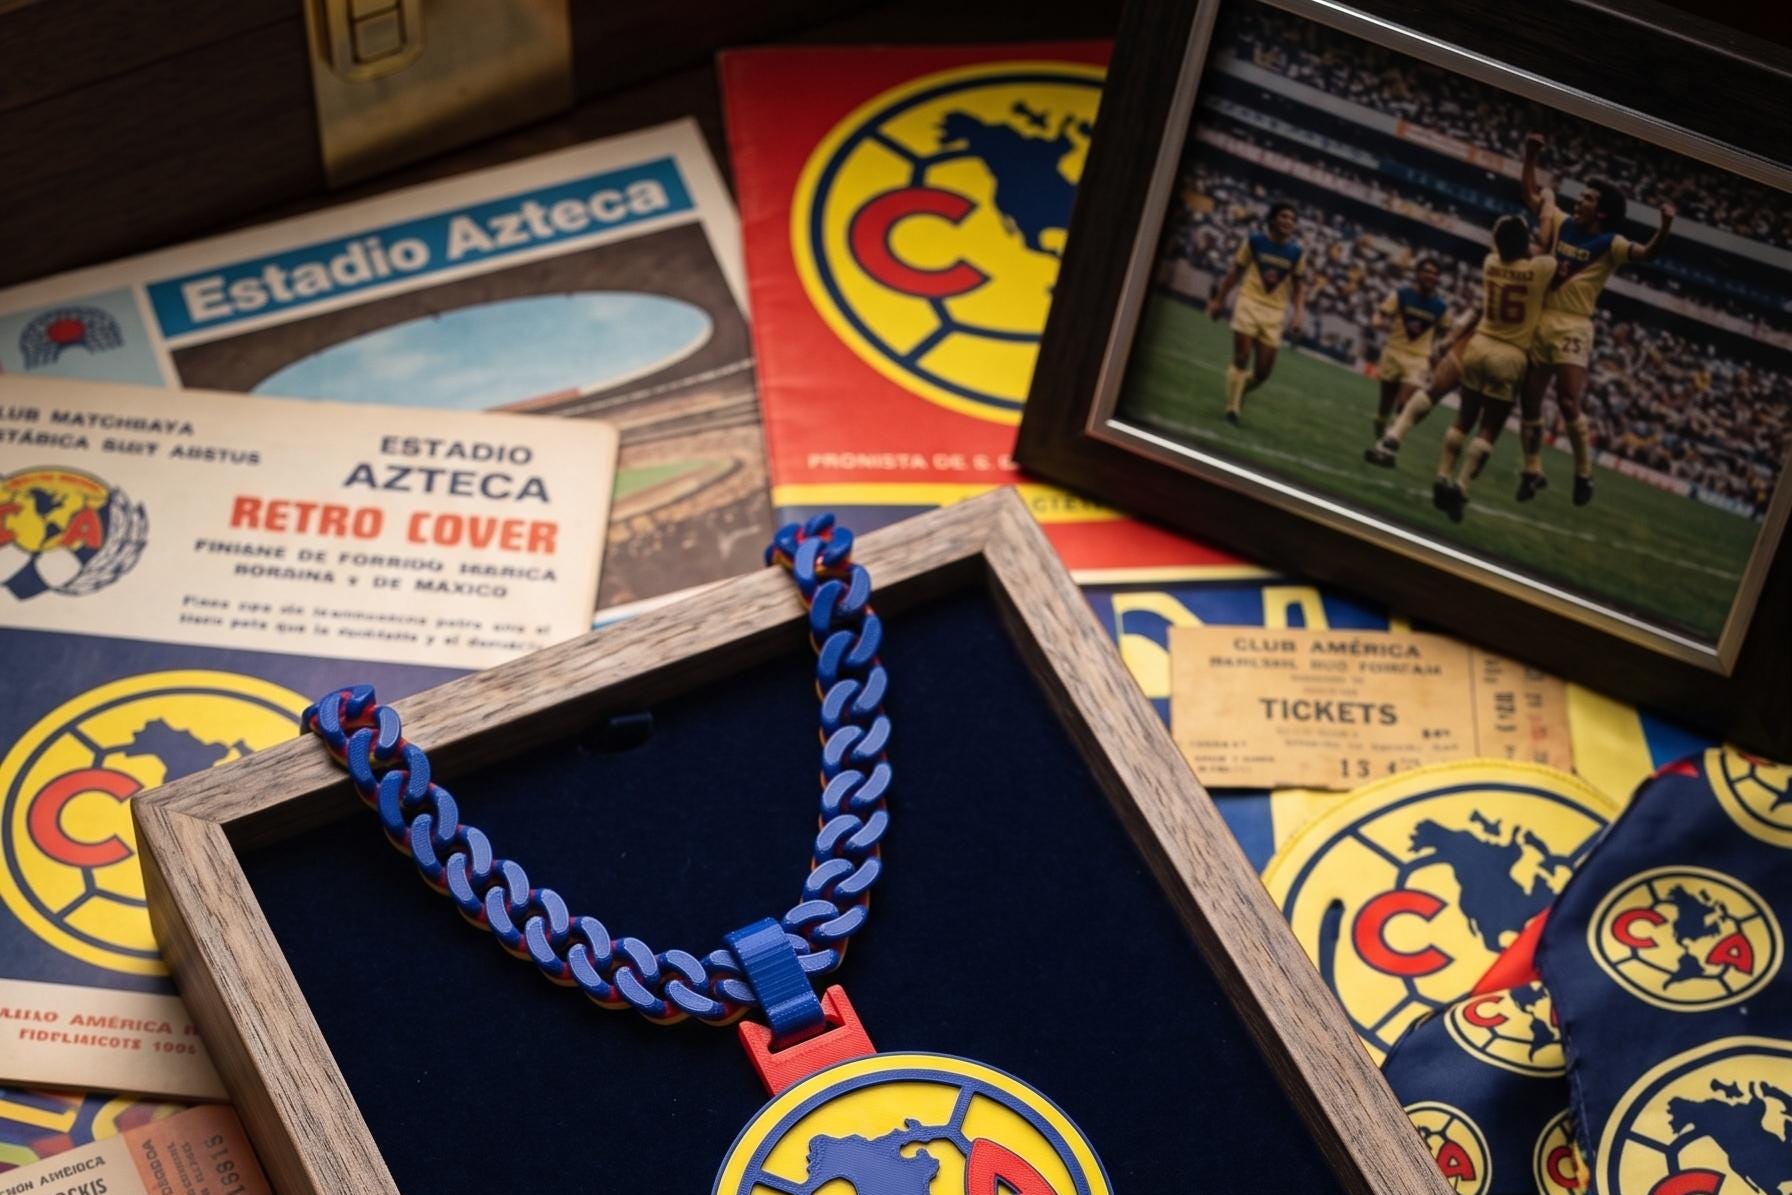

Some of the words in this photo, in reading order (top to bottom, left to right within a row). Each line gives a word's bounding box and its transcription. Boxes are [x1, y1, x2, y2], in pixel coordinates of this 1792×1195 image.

[181, 234, 430, 324] Estadio
[446, 178, 669, 260] Azteca
[849, 186, 992, 300] C
[0, 406, 40, 424] LUB
[379, 434, 534, 466] ESTADIO
[343, 463, 552, 503] AZTECA
[229, 495, 385, 540] RETRO
[407, 512, 560, 555] COVER
[298, 548, 327, 564] DE
[1233, 636, 1297, 652] CLUB
[1311, 635, 1421, 659] AMÉRICA
[1258, 697, 1398, 726] TICKETS
[26, 767, 145, 867] C
[1352, 890, 1454, 977] C
[1611, 907, 1669, 950] C
[1705, 932, 1755, 978] A
[69, 1013, 173, 1035] AMÉRICA
[1462, 994, 1510, 1028] C
[1435, 1139, 1477, 1182] A
